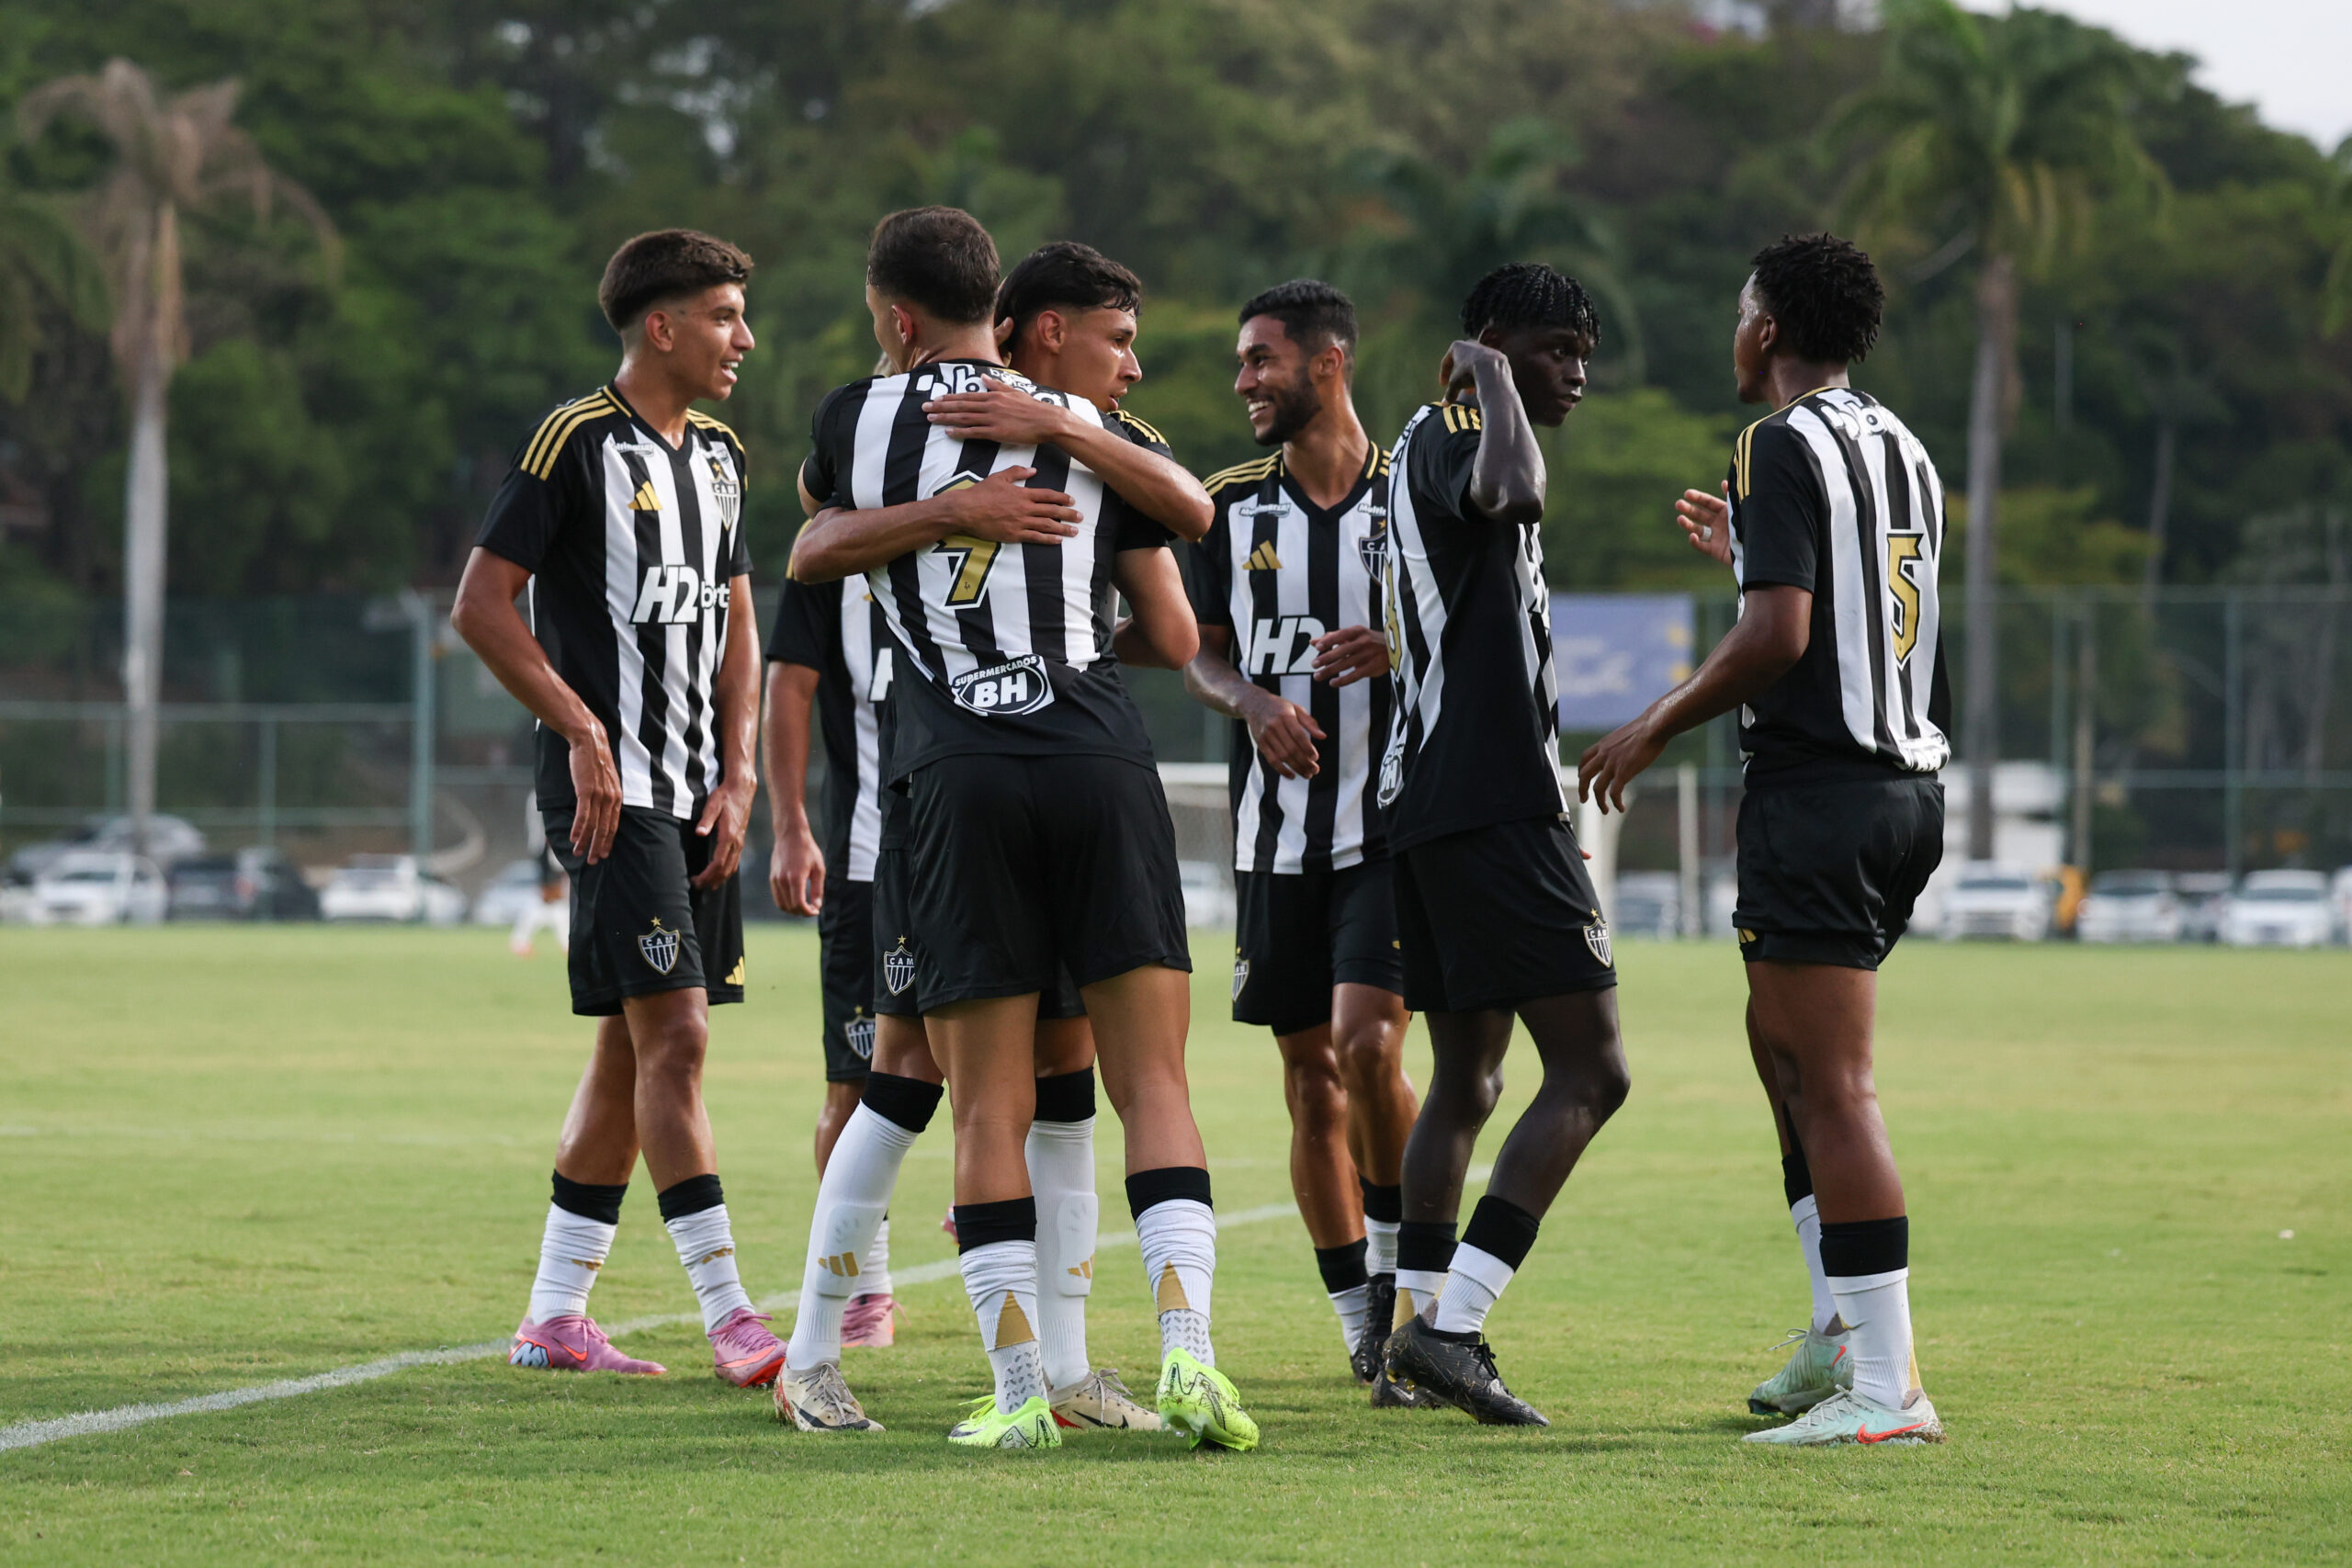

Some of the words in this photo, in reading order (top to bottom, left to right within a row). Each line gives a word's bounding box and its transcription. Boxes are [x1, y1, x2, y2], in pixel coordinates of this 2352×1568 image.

[1886, 532, 1925, 664] 5
[955, 656, 1037, 687] SUPERMERCADOS
[973, 671, 1027, 708] BH
[646, 935, 673, 946] CAM
[889, 957, 914, 965] CAM
